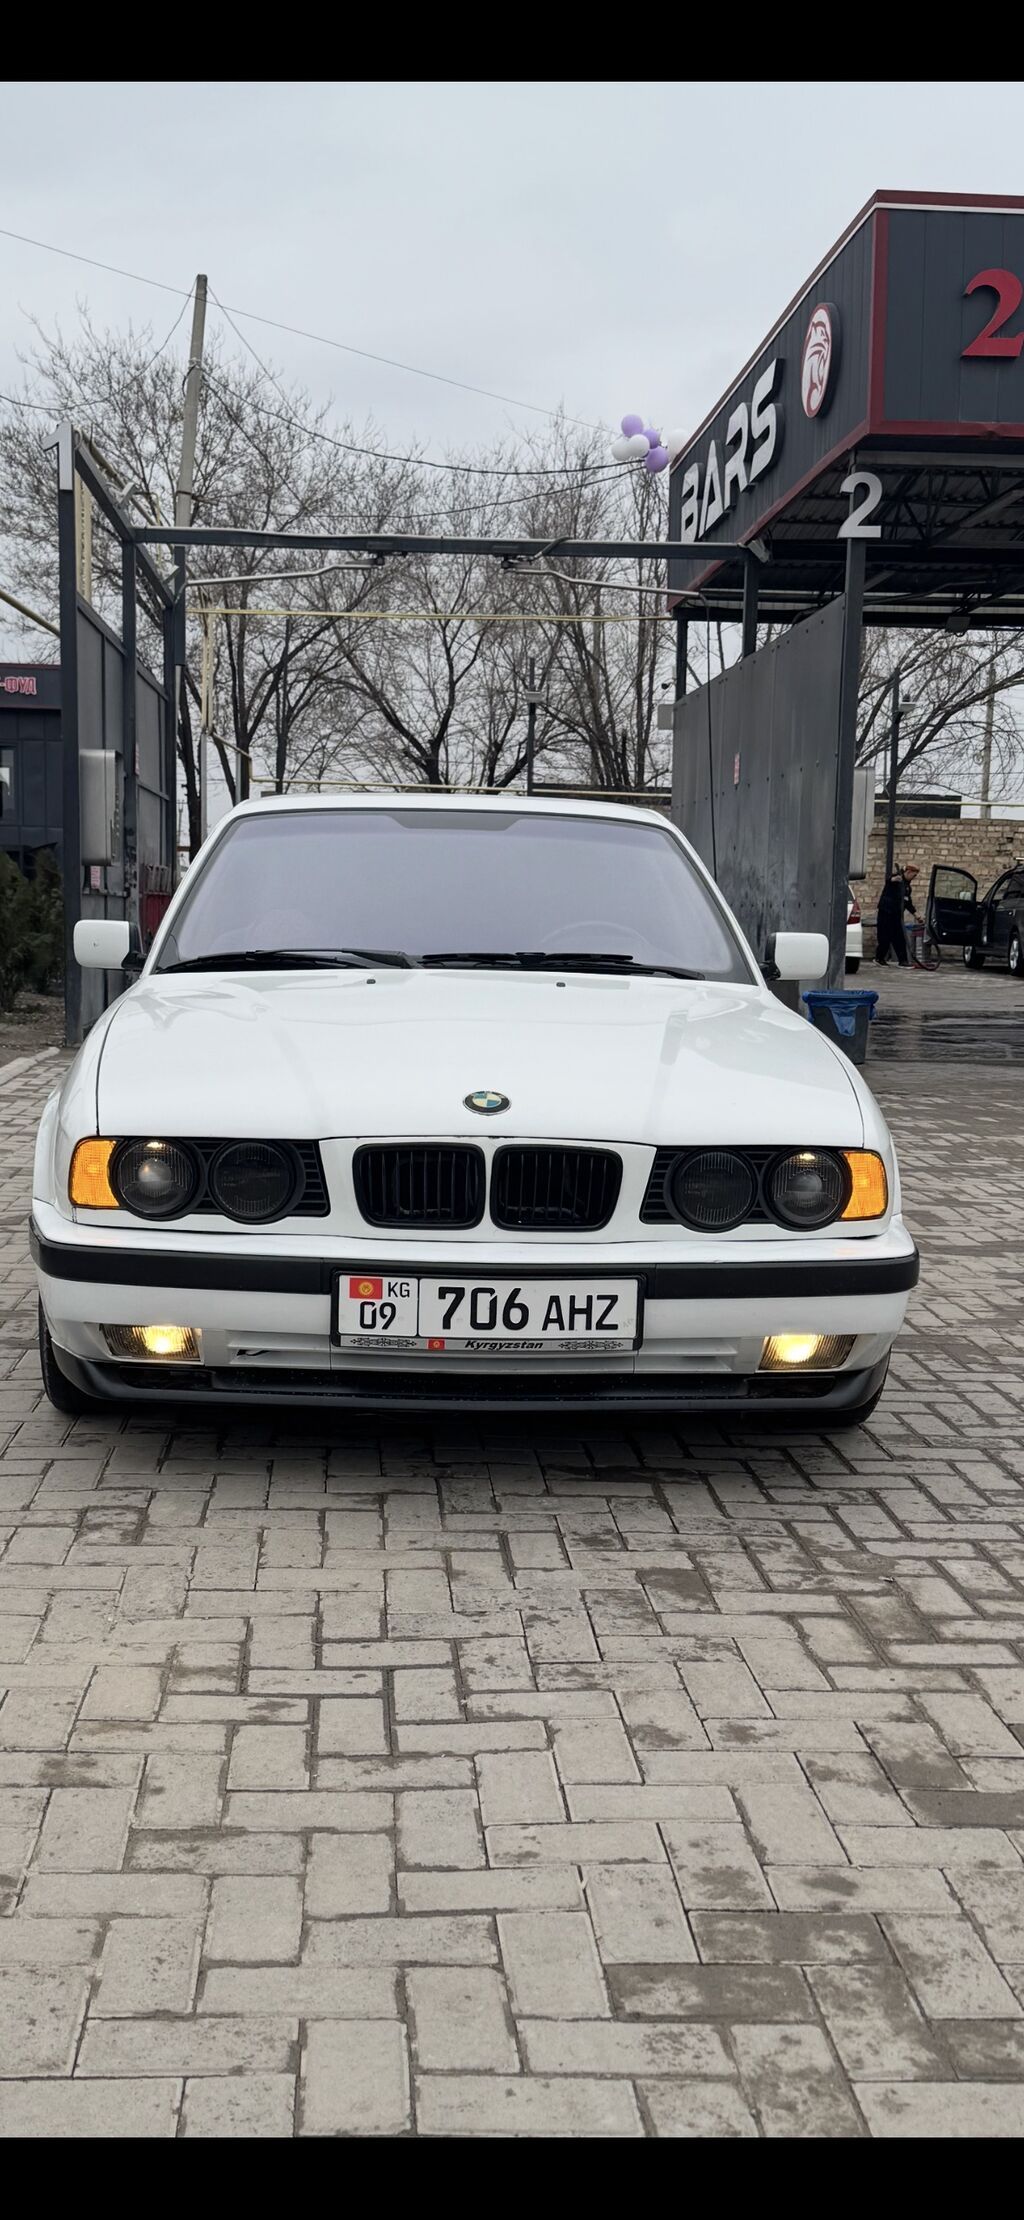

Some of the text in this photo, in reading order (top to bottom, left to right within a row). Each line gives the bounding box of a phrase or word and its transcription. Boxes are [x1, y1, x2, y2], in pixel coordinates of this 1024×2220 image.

[42, 424, 74, 490] 1
[680, 358, 784, 543] BARS
[837, 471, 883, 539] 2
[387, 1282, 410, 1298] KG
[438, 1286, 619, 1331] 706 AHZ
[359, 1301, 397, 1330] 09
[464, 1339, 544, 1351] Kyrgyzstan
